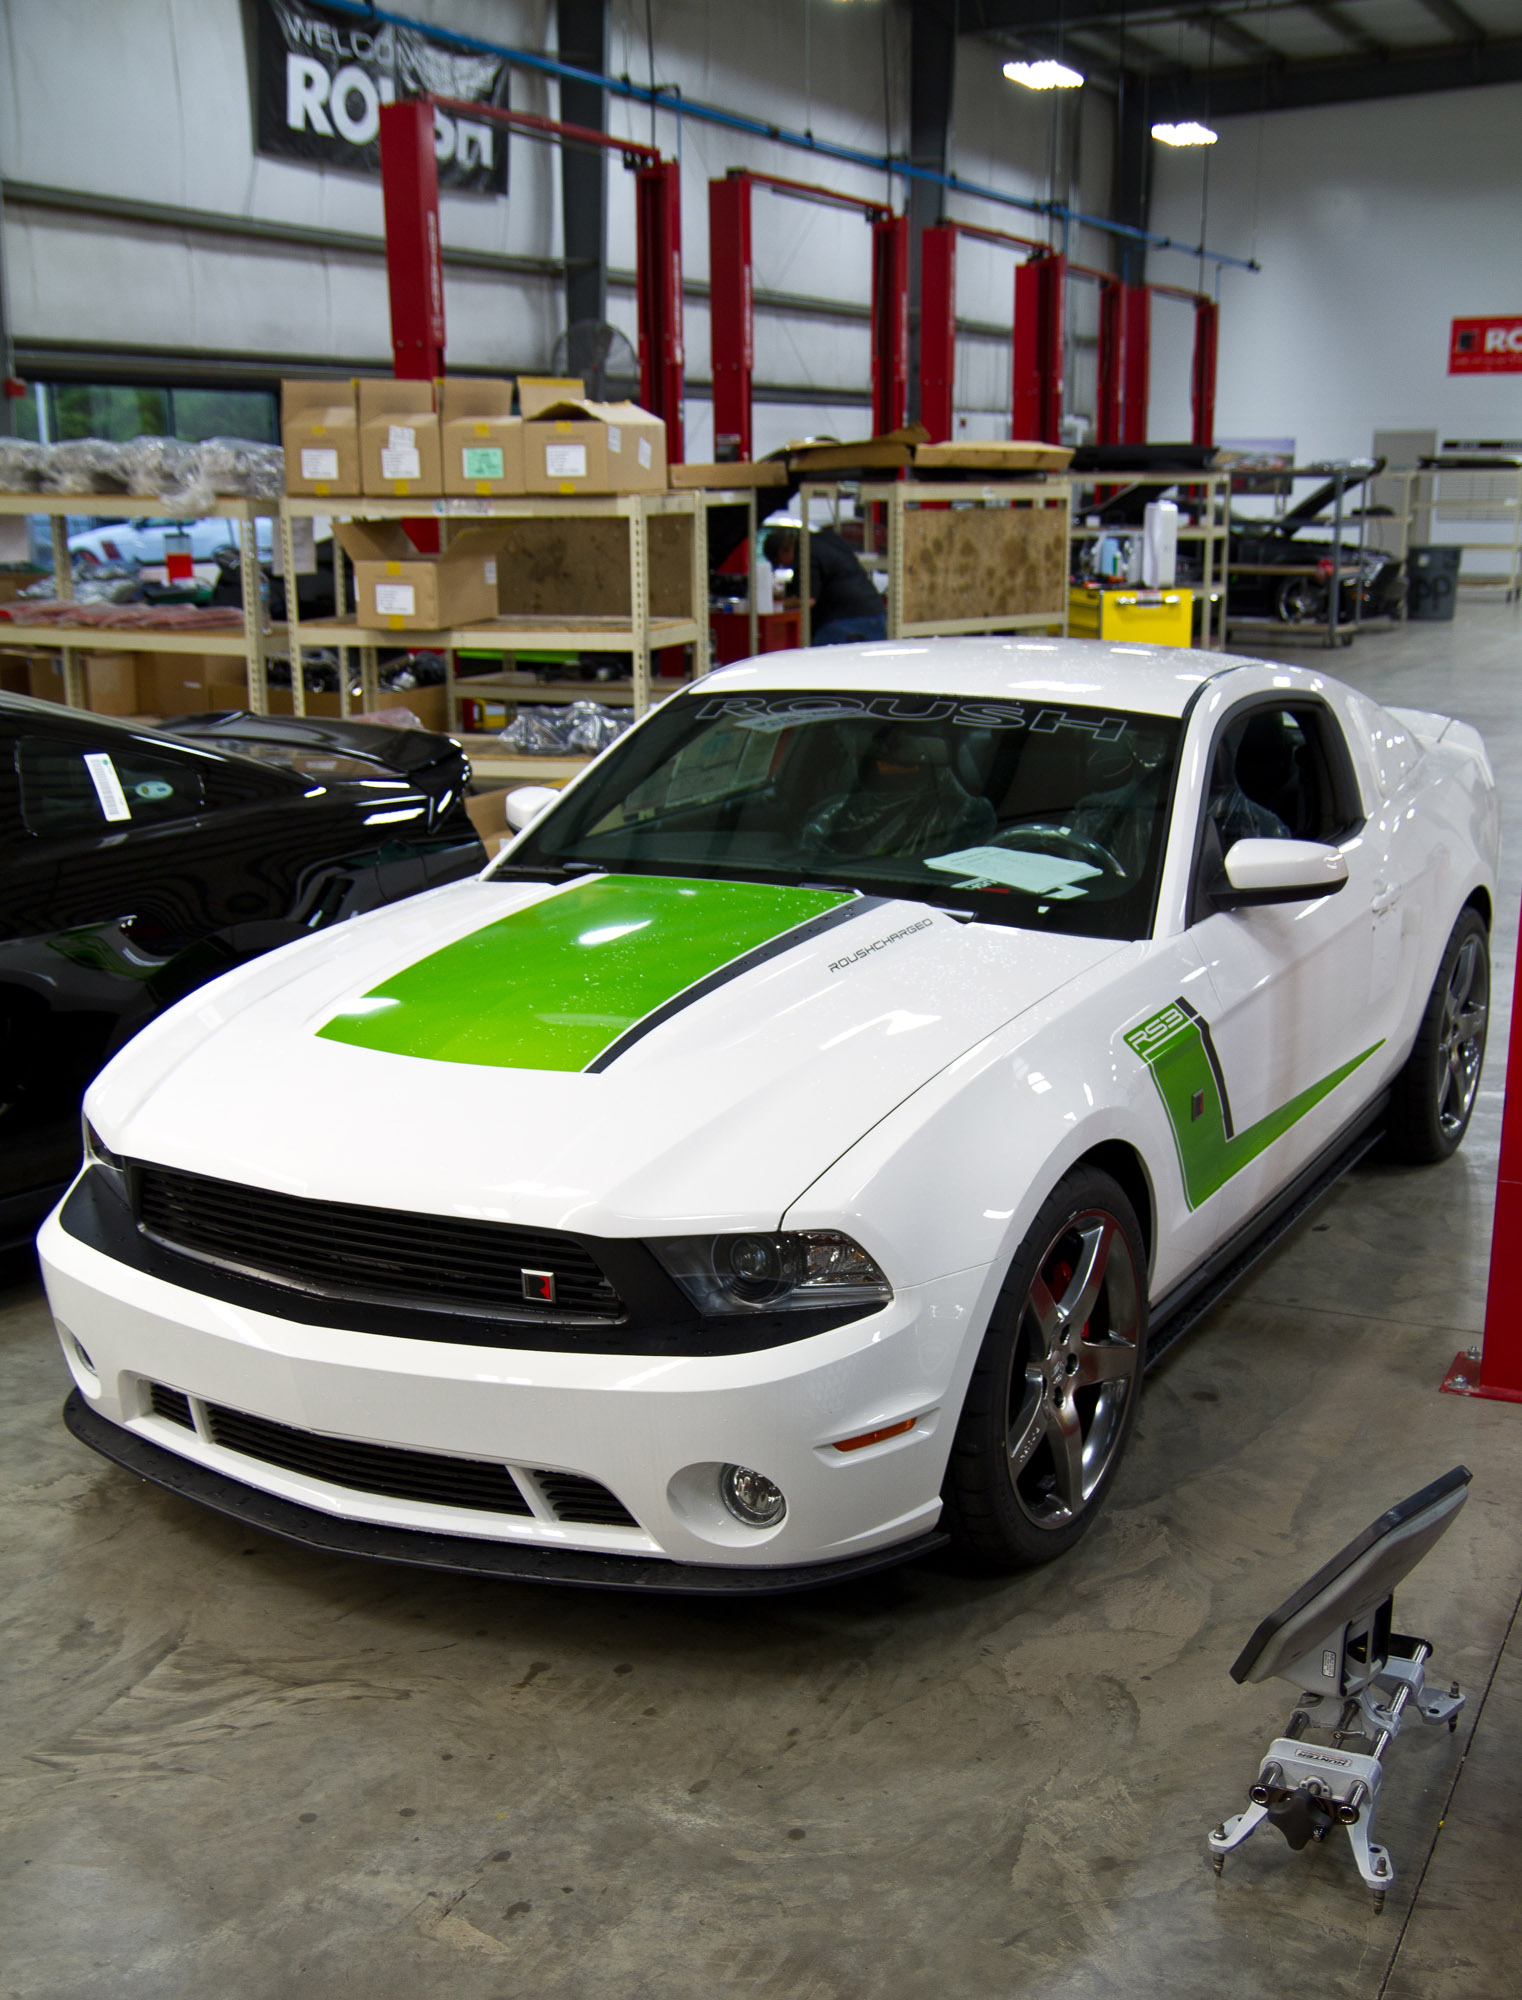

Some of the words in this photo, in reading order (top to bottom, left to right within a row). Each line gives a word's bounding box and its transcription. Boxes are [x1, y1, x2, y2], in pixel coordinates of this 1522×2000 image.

[287, 51, 493, 171] ROSH
[695, 695, 1128, 741] ROUSH
[827, 917, 934, 974] ROUSHCHARGED
[1127, 1007, 1184, 1051] RS3
[1298, 1752, 1348, 1766] HUNTER
